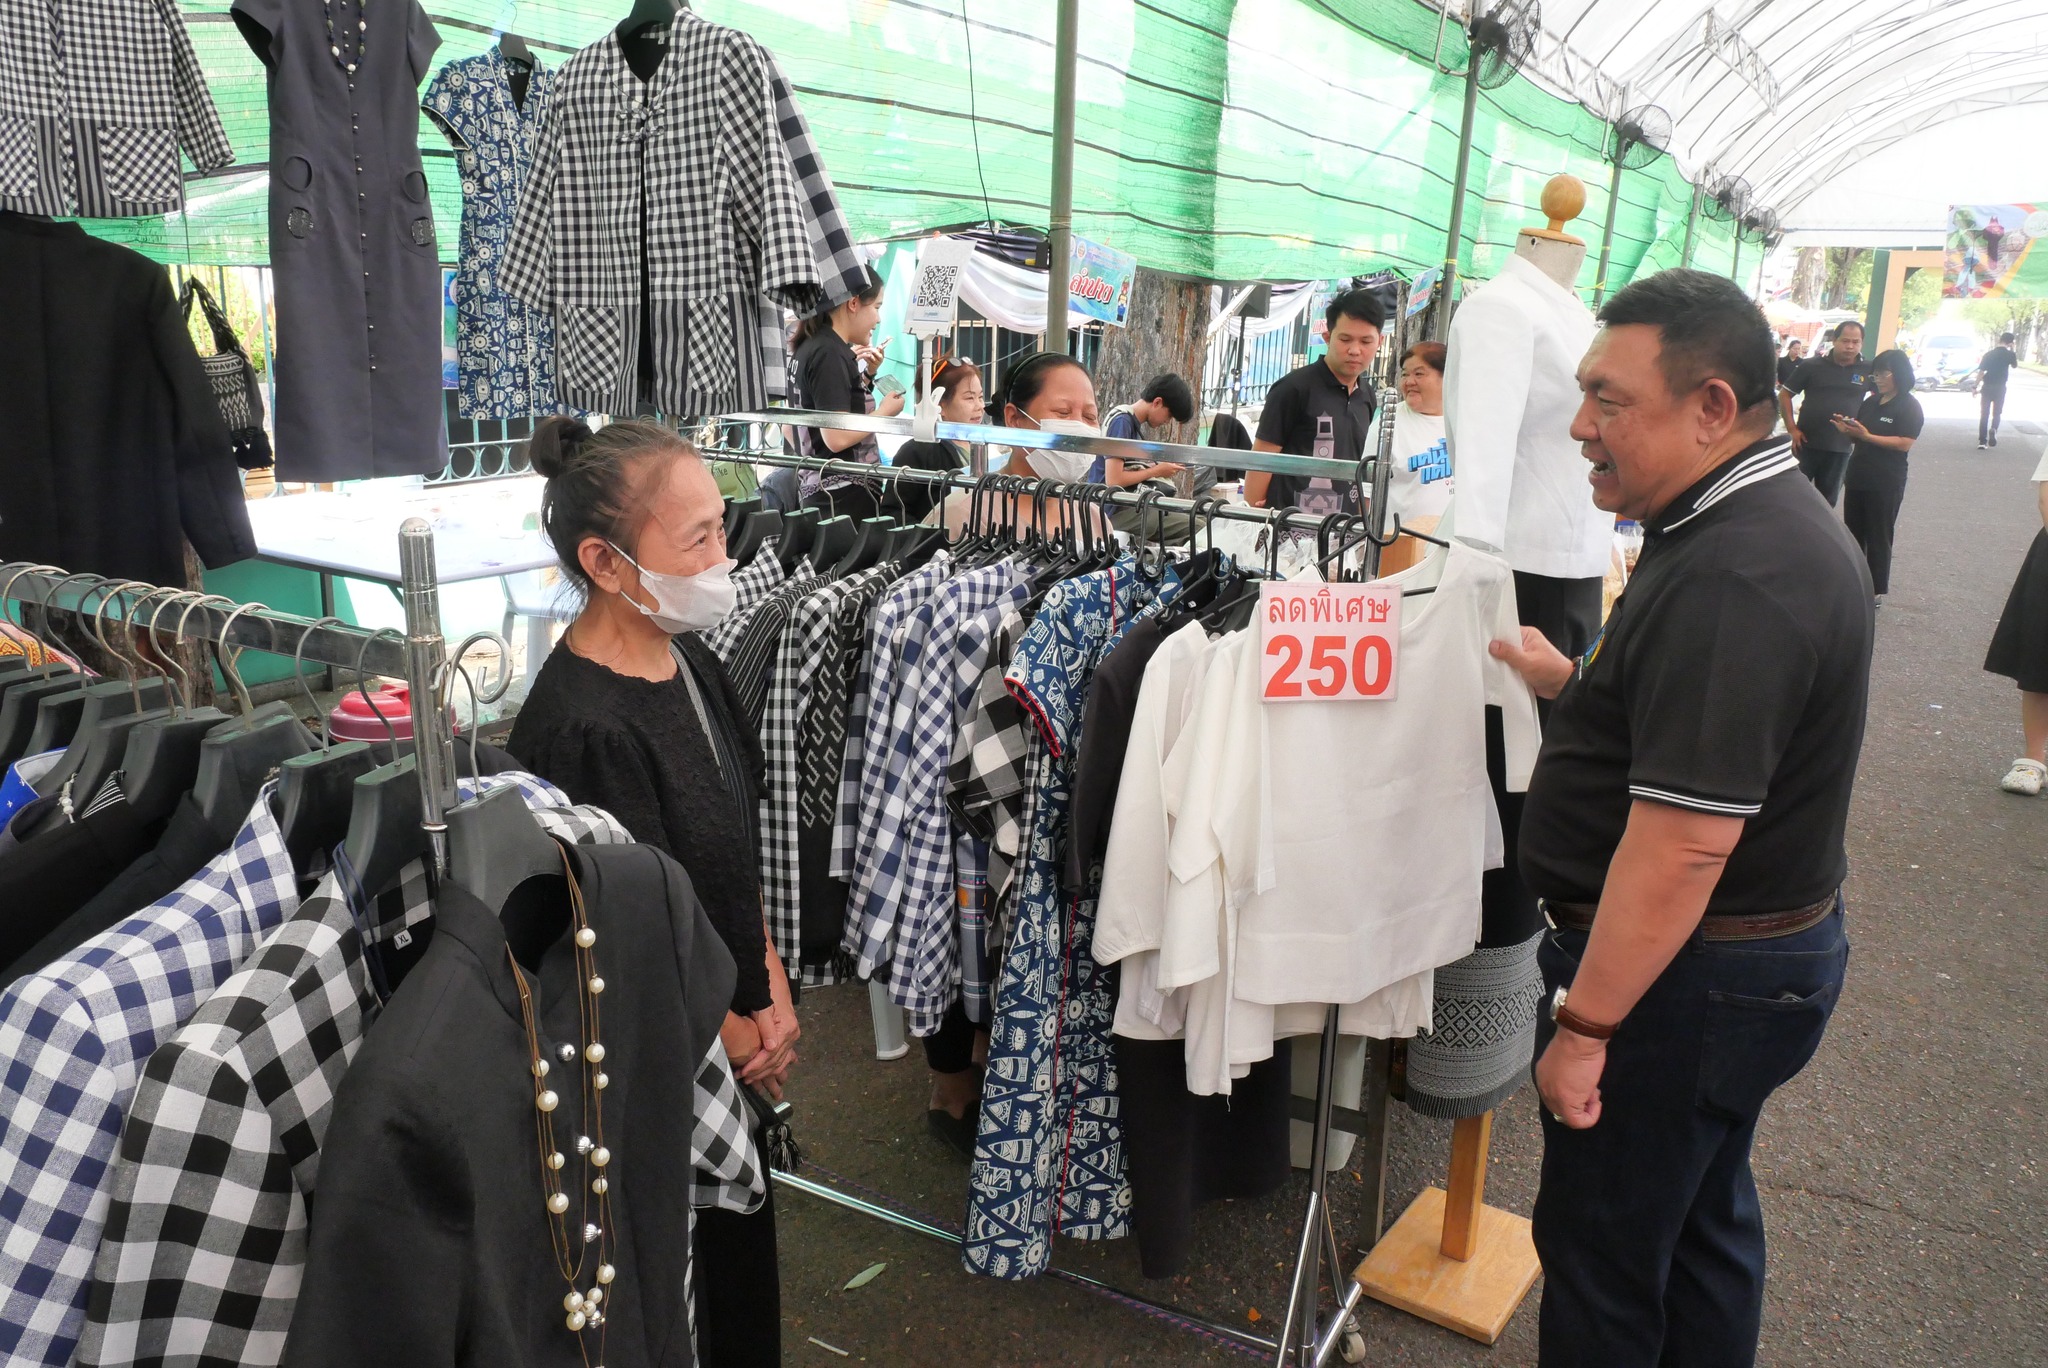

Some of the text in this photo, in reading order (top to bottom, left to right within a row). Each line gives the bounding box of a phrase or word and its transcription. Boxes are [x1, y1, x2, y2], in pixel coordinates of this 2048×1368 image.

[1269, 589, 1391, 623] ลดพิเศษ
[1264, 634, 1392, 697] 250
[398, 934, 409, 944] XL
